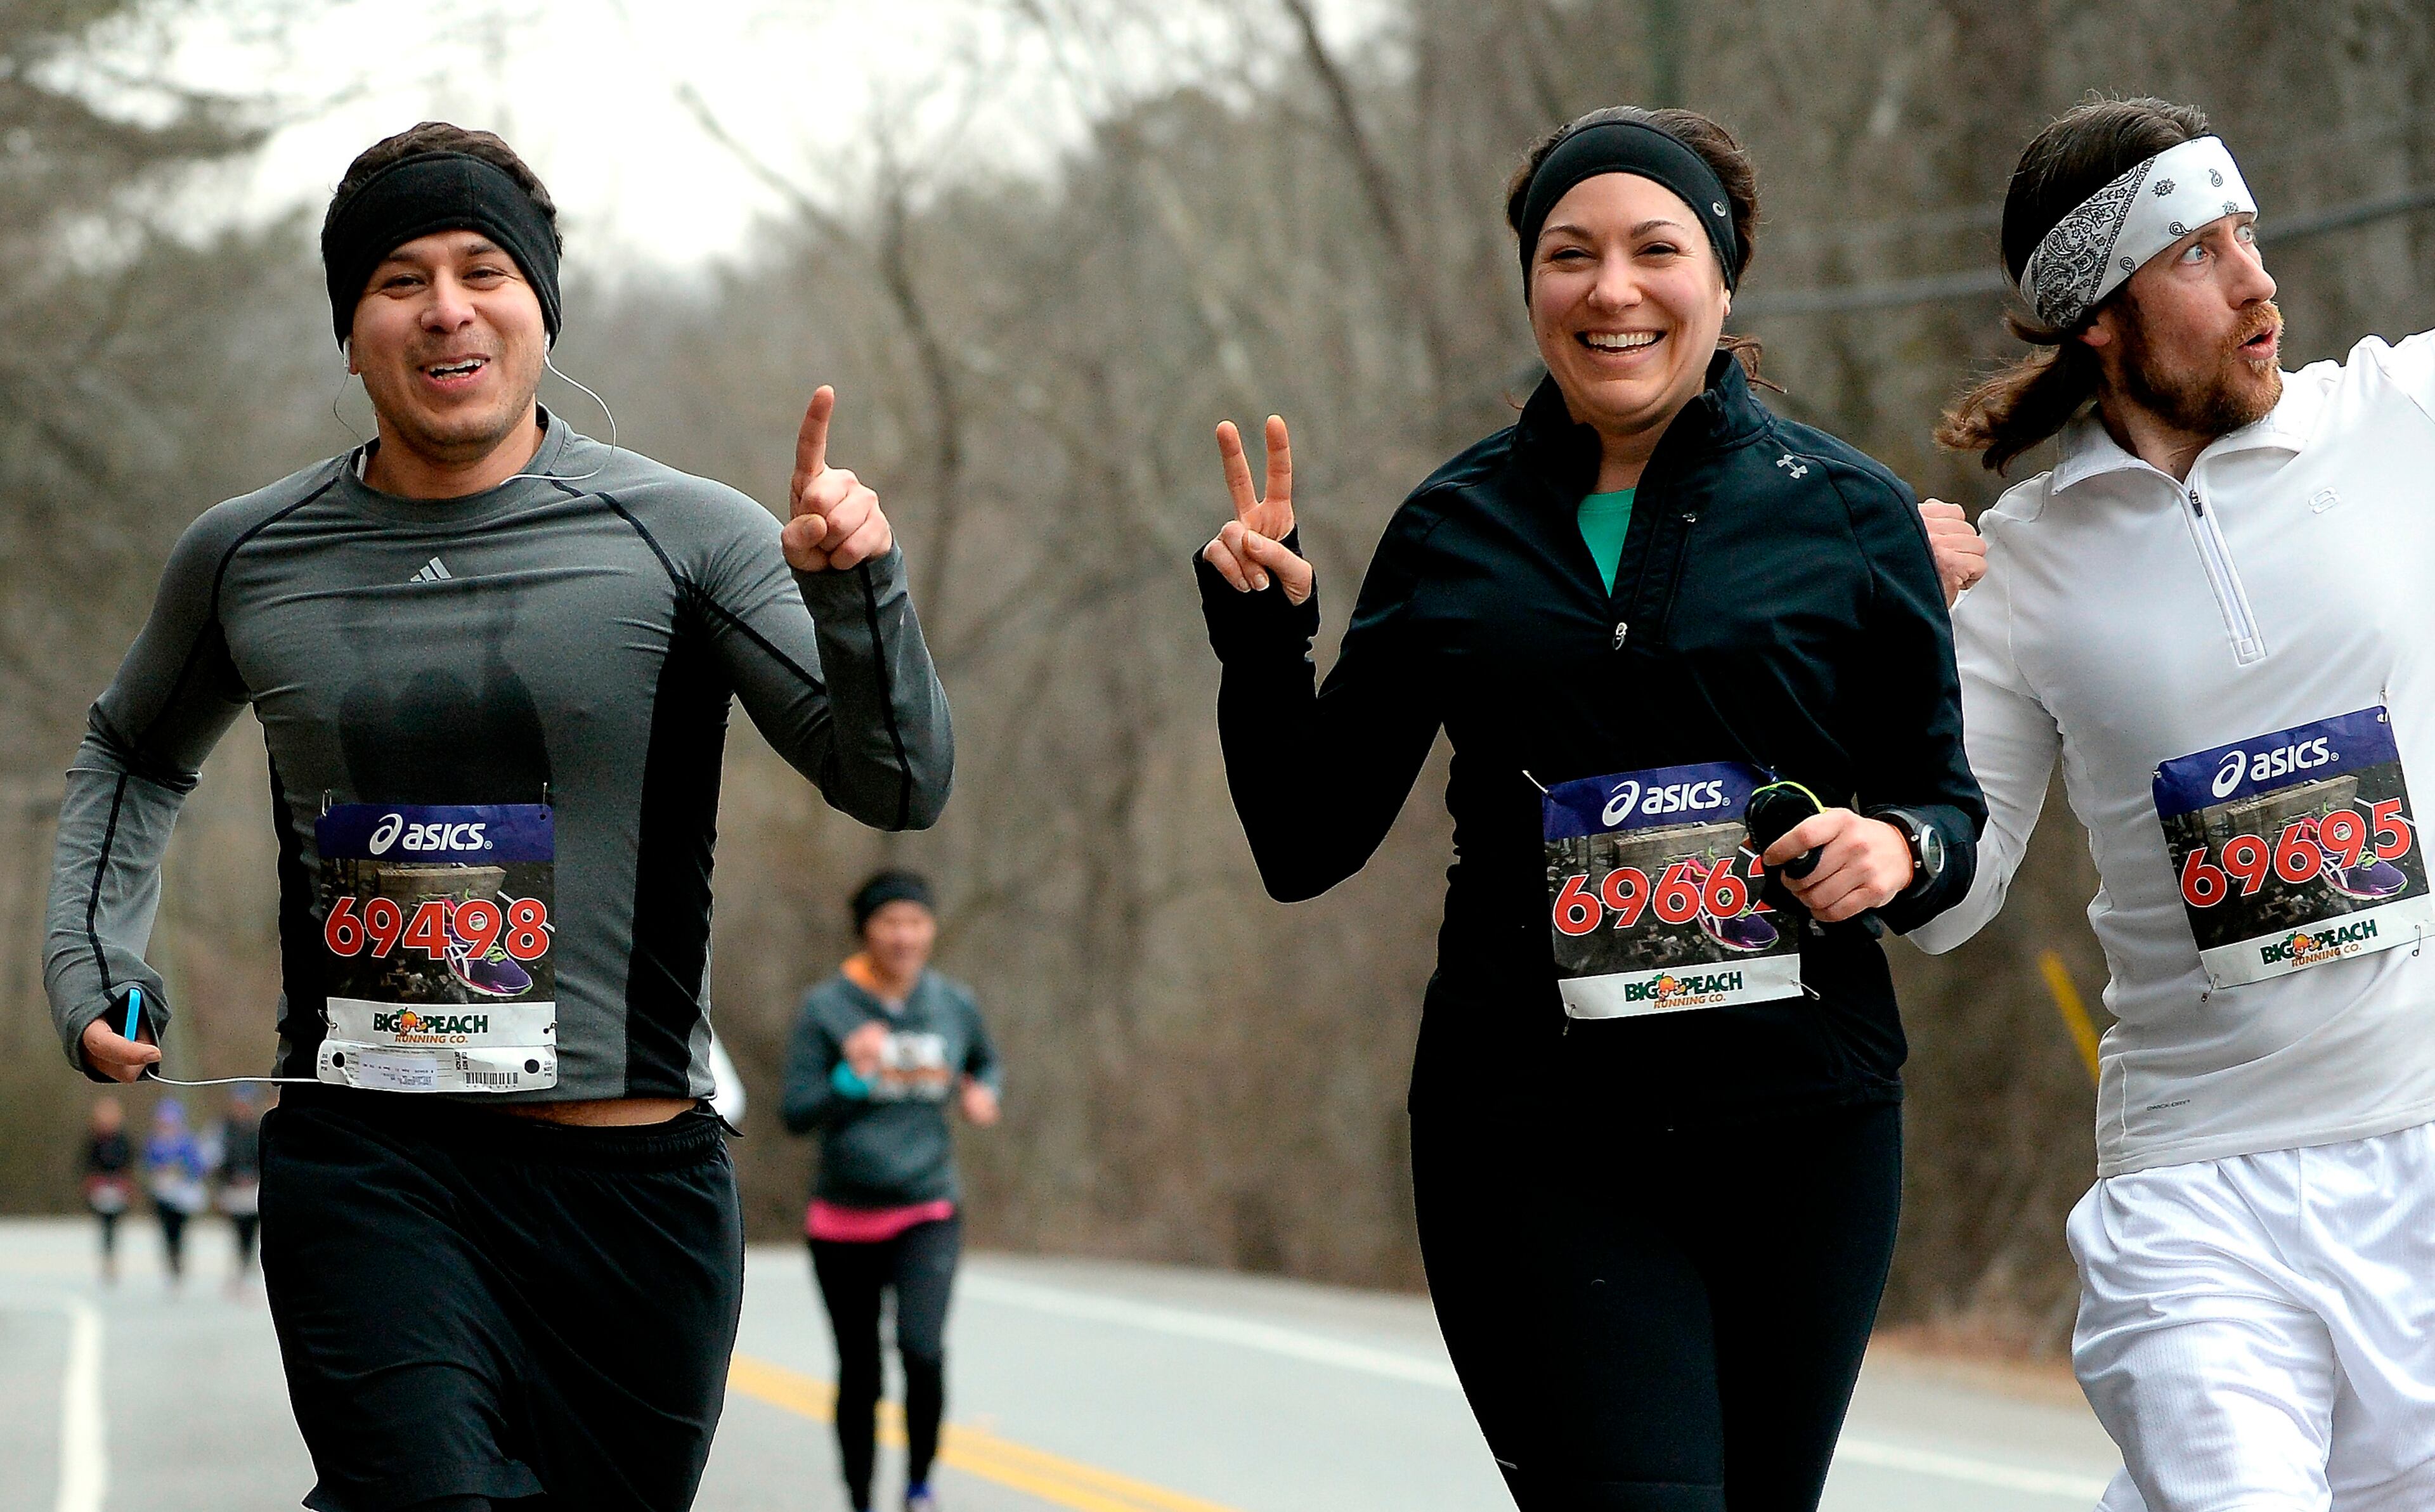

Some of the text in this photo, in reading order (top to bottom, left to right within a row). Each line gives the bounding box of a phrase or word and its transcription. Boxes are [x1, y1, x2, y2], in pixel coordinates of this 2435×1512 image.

[2181, 796, 2412, 908] 69695
[324, 896, 550, 960] 69498
[2291, 943, 2362, 967] RUNNING CO.
[1653, 993, 1726, 1009] RUNNING CO.
[394, 1034, 468, 1044] RUNNING CO.
